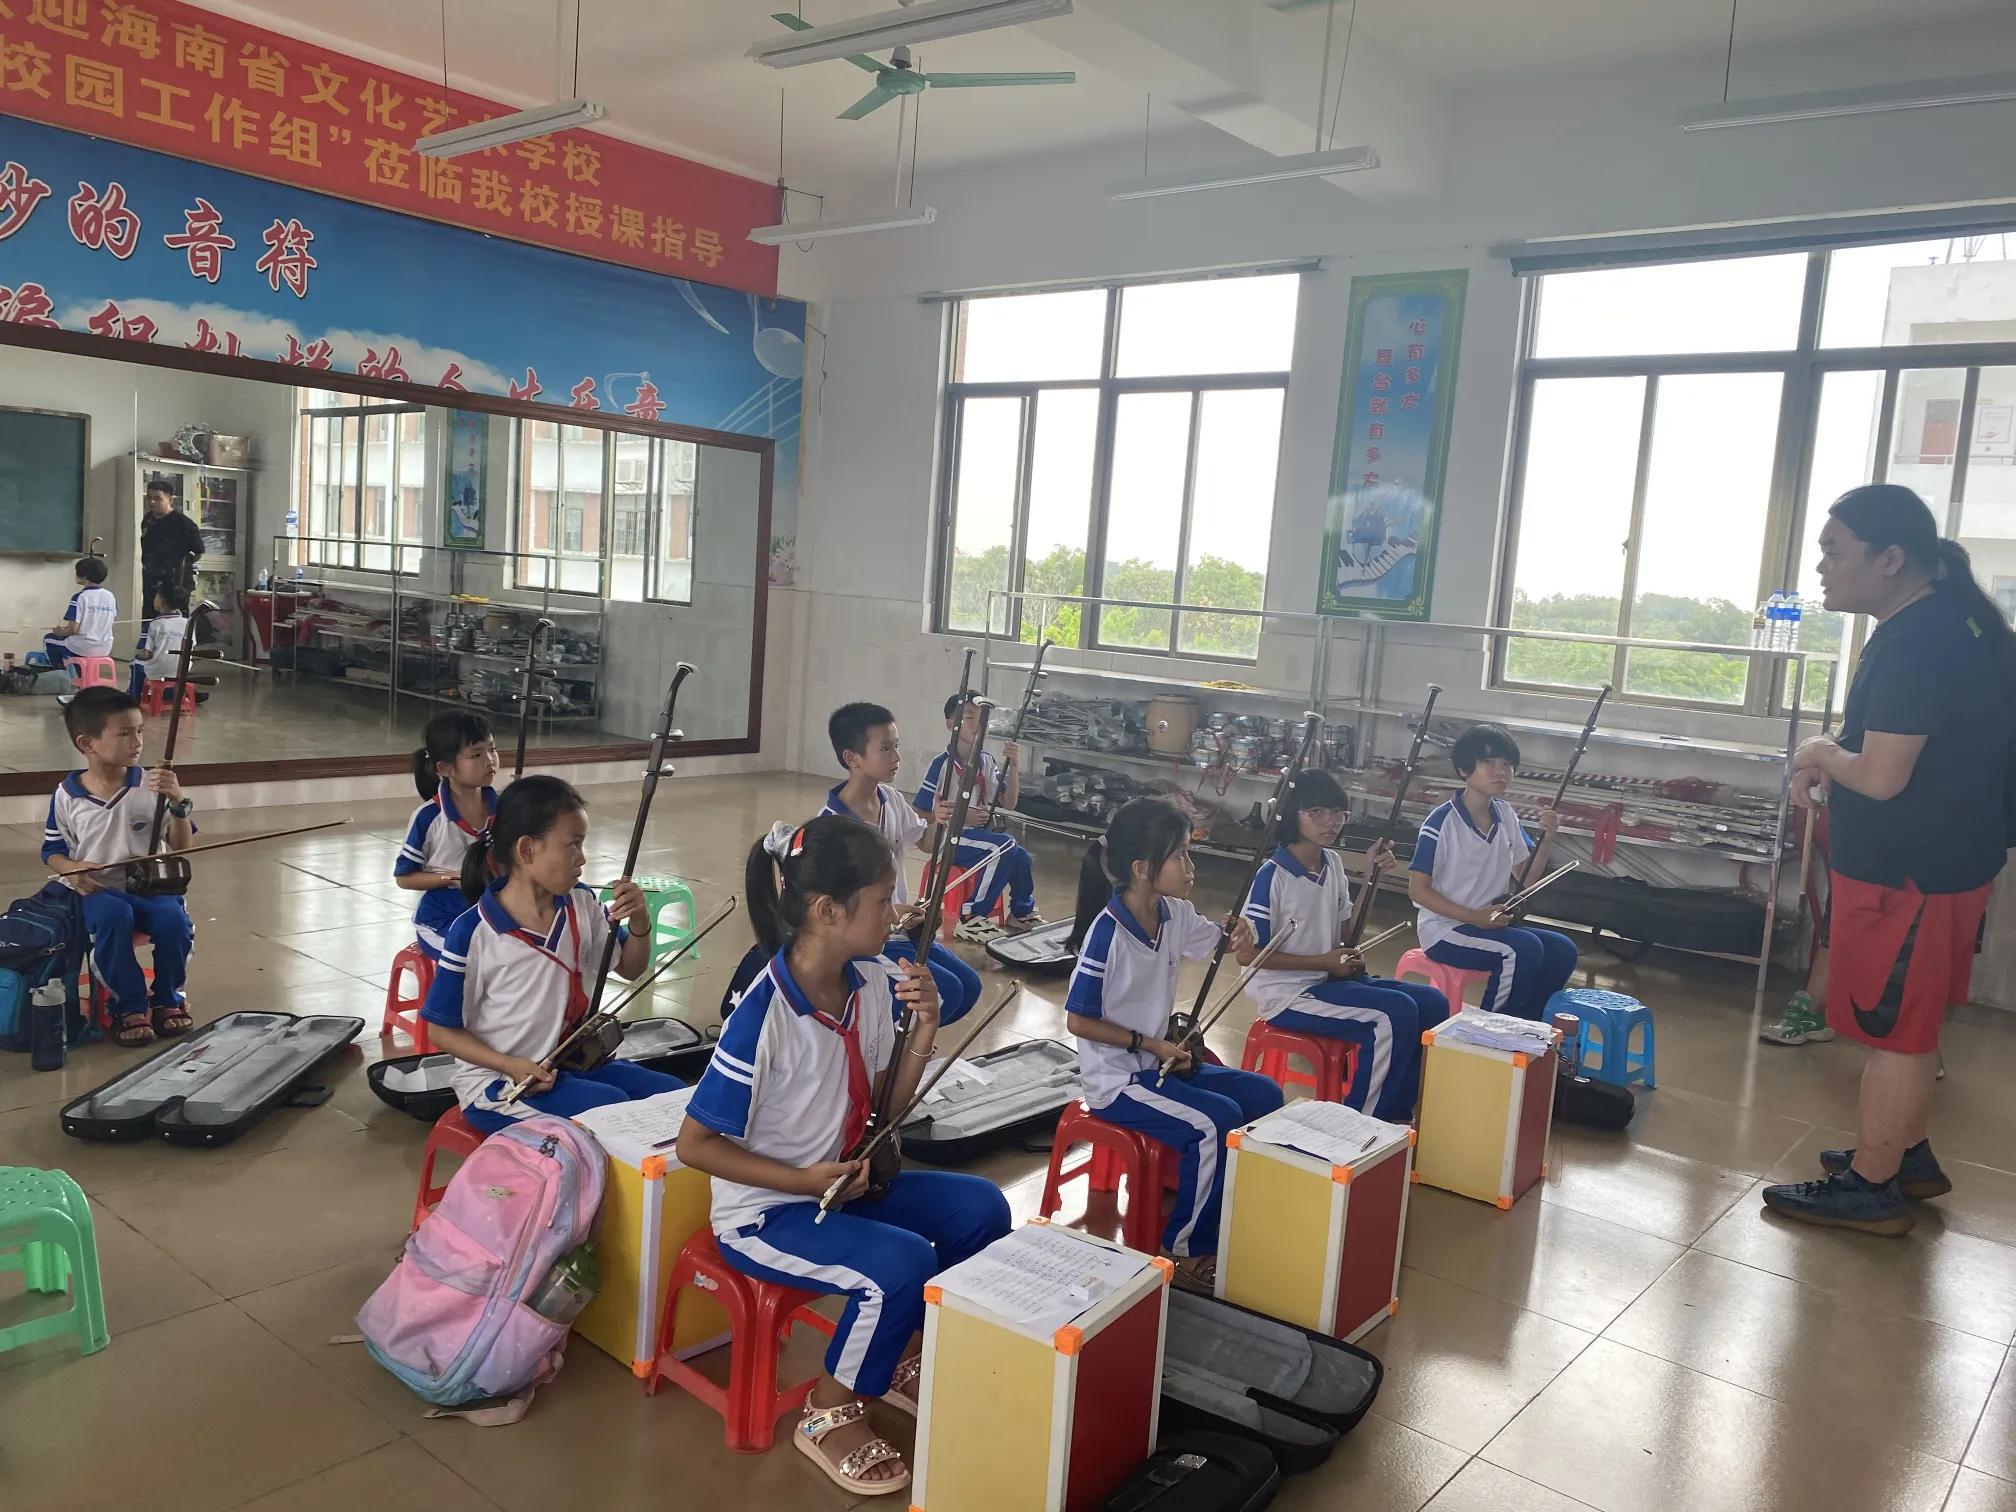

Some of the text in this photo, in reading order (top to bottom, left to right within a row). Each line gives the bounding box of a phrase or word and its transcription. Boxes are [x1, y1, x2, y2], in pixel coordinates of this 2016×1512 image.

[0, 0, 602, 187] 迎海南省文化艺学校
